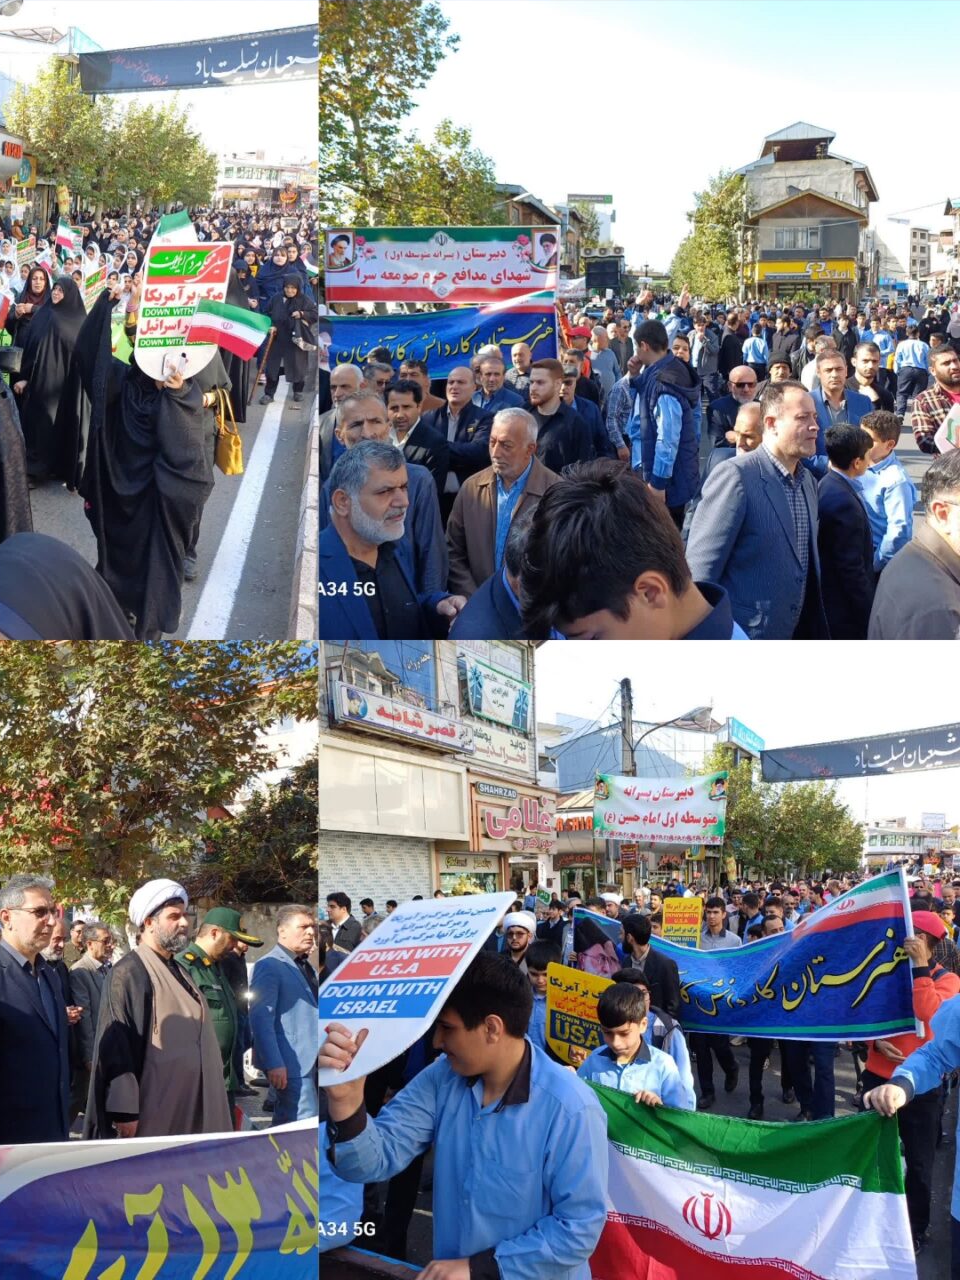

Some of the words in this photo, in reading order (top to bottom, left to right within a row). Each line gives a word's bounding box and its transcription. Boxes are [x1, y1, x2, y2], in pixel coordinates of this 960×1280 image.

[194, 46, 212, 85] باد
[210, 42, 259, 83] تسلیت
[462, 247, 507, 265] دبیرستان
[355, 269, 378, 285] سرا
[380, 272, 419, 287] صومعه
[421, 271, 449, 286] حرم
[451, 269, 488, 287] مدافع
[490, 267, 532, 286] شهدای
[143, 285, 186, 307] آمریکا
[182, 291, 196, 306] بر
[144, 308, 172, 318] DOWN
[173, 306, 195, 316] WITH
[139, 318, 182, 336] اسرائیل
[139, 337, 166, 348] DOWN
[375, 705, 424, 730] شانه
[425, 722, 457, 738] قصر
[853, 742, 869, 775] باد
[867, 737, 908, 772] تسلیت
[479, 783, 518, 799] SHAHRZAD
[623, 785, 652, 802] پسرانه
[652, 786, 694, 802] دبیرستان
[485, 794, 553, 840] غلامی
[618, 812, 641, 825] حسین
[642, 811, 661, 826] امام
[661, 811, 679, 829] اول
[680, 811, 719, 829] متوسطه
[430, 910, 452, 921] مرگ
[451, 907, 471, 919] شعار
[469, 906, 498, 918] همین
[393, 922, 428, 934] اسرائیل
[438, 921, 461, 930] مرگ
[411, 931, 436, 942] مرگ
[452, 930, 479, 941] برای
[350, 949, 416, 964] DOWN
[413, 946, 468, 960] WITH
[368, 962, 421, 977] U.S.A
[781, 928, 909, 1011] هنرستان
[321, 983, 386, 999] DOWN
[383, 981, 446, 996] WITH
[549, 976, 581, 993] آمریکا
[696, 962, 779, 1016] کاردانش
[330, 999, 399, 1015] ISRAEL
[555, 1014, 581, 1025] DOWN
[554, 1019, 600, 1047] USA
